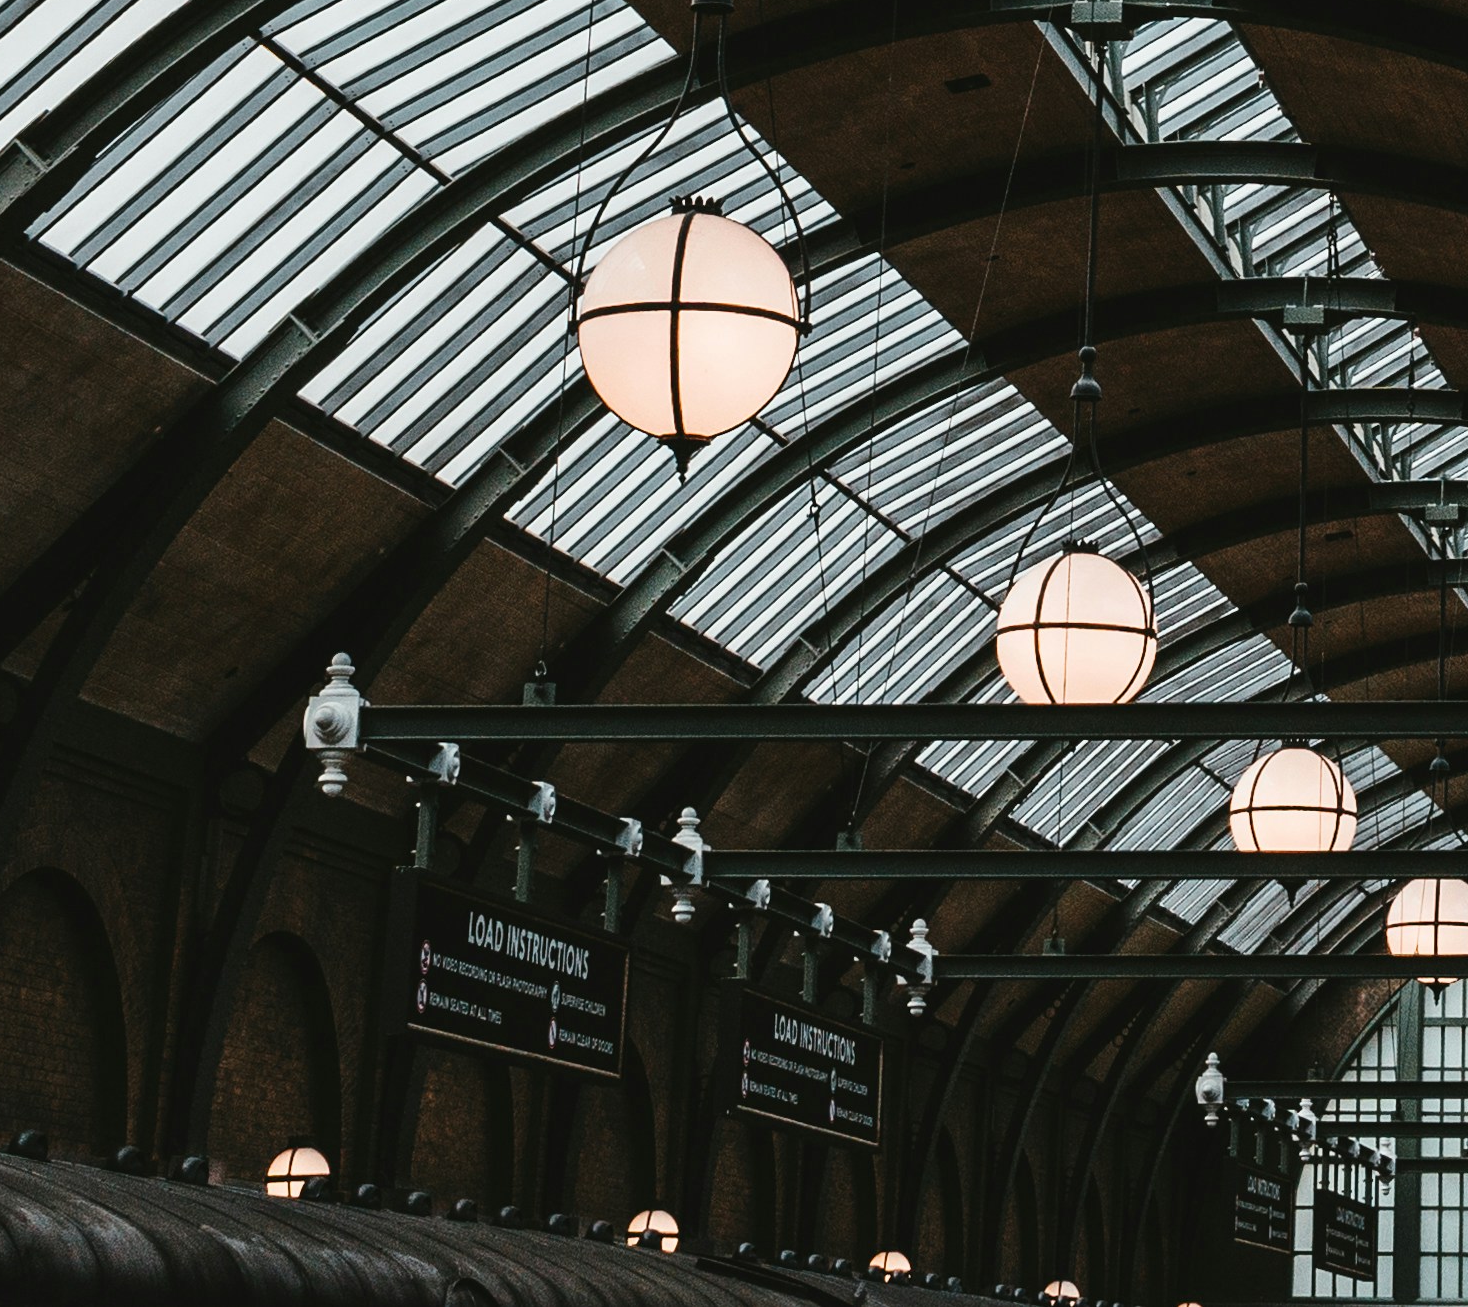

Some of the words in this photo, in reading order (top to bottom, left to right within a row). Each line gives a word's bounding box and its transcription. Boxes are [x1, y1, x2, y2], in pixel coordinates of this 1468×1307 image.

[468, 911, 504, 952] LOAD
[506, 924, 590, 980] INSTRUCTIONS
[774, 1012, 798, 1045] LOAD
[799, 1022, 856, 1066] INSTRUCTIONS
